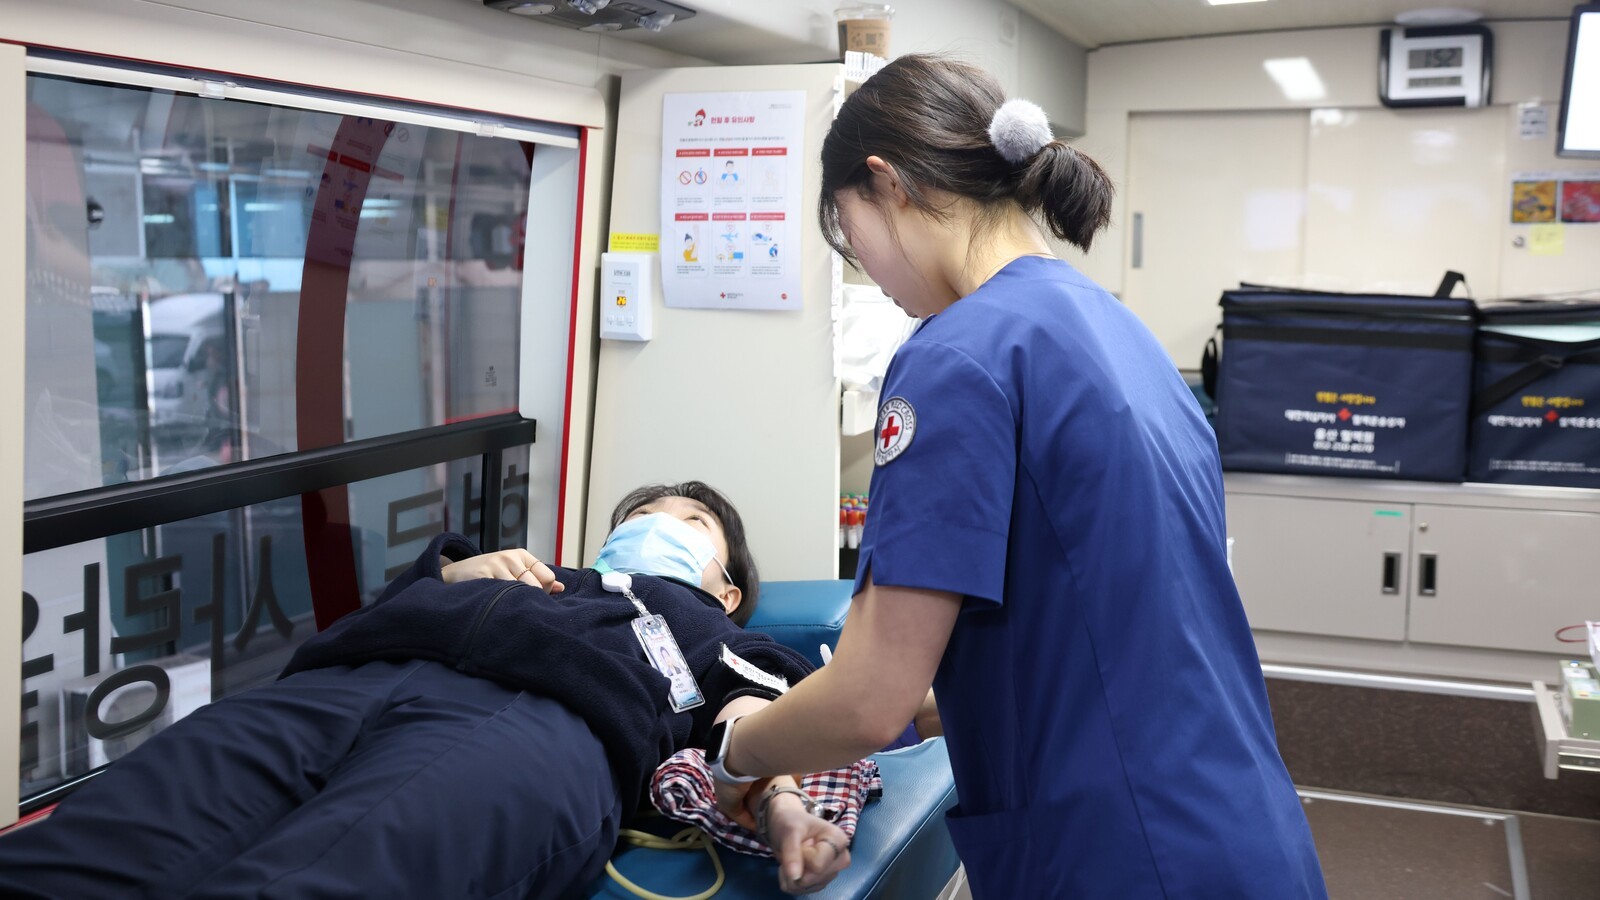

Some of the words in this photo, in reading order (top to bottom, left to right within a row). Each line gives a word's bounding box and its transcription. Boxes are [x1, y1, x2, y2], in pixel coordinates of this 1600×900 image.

[710, 116, 723, 124] 헌혈
[731, 115, 755, 124] 유의사항
[901, 405, 913, 431] CROSS
[1314, 427, 1338, 442] 울산
